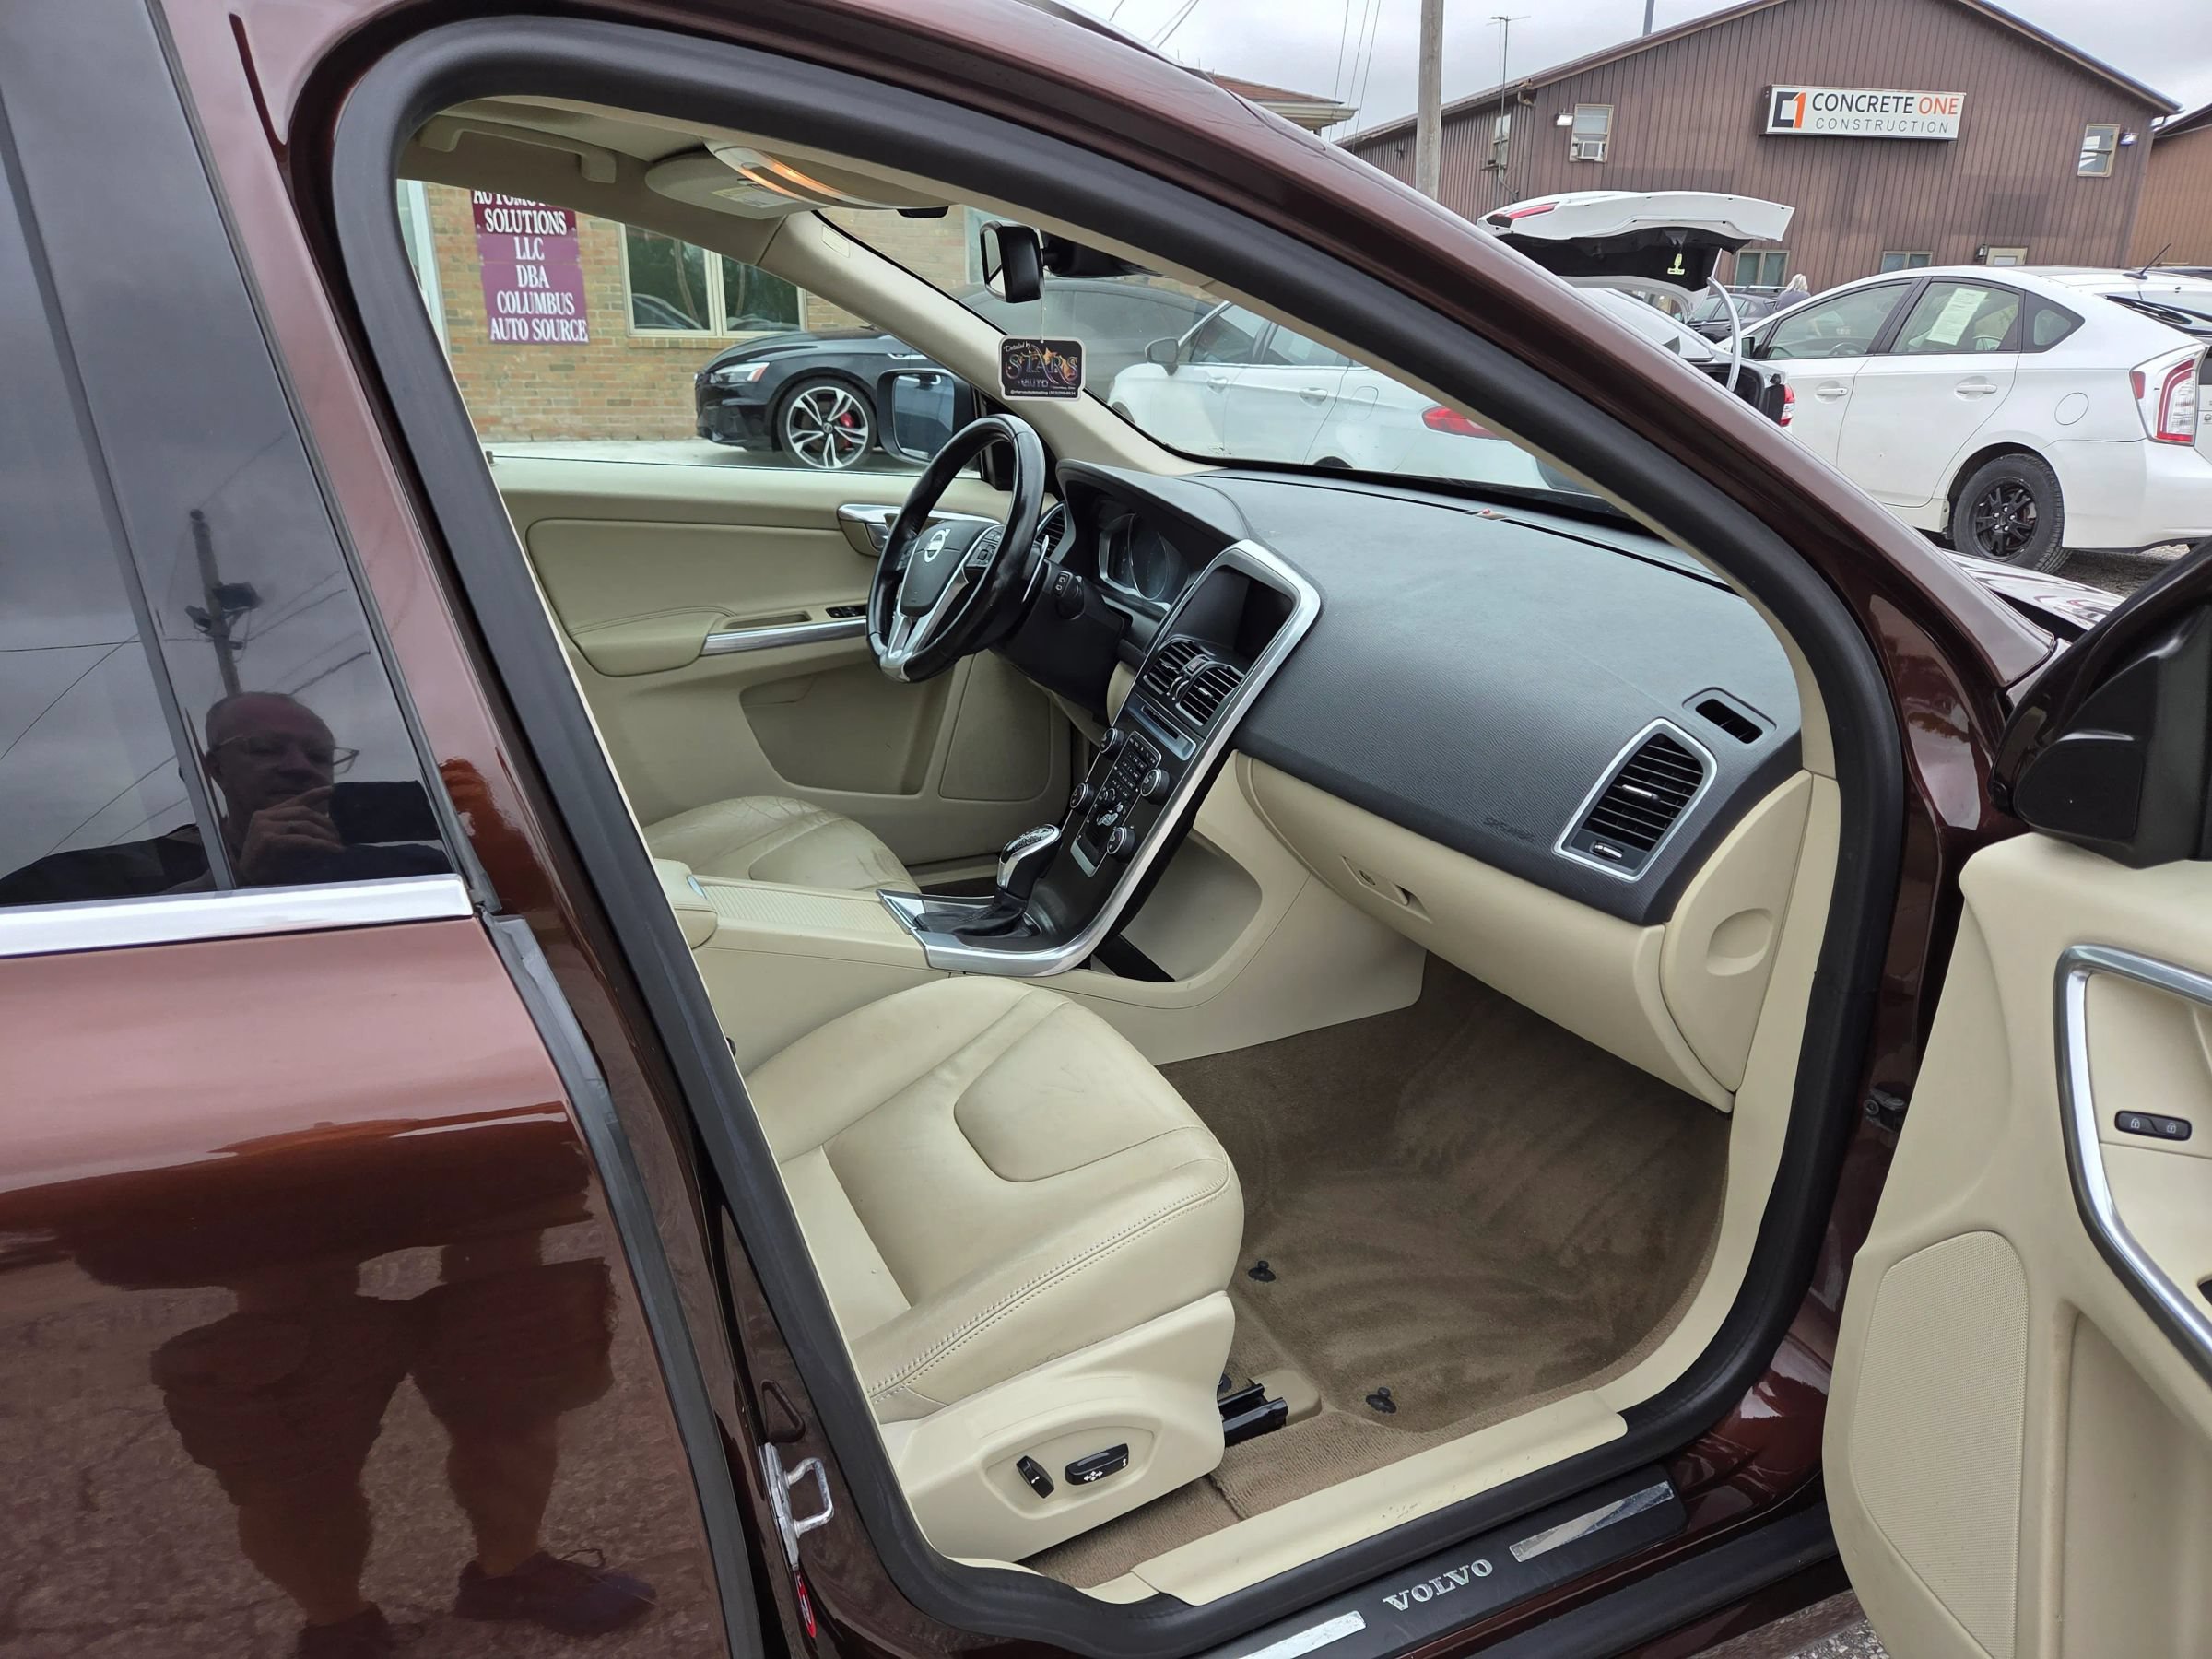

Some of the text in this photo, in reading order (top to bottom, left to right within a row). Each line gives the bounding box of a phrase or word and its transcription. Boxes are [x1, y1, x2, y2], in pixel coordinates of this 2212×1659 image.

[1812, 92, 1959, 115] CONCRETE ONE
[1815, 117, 1948, 134] CONSTRUCTION
[484, 208, 567, 236] SOLUTIONS
[513, 236, 545, 261] LLC
[516, 265, 550, 288] DBA
[497, 290, 576, 316] COLUMBUS
[490, 317, 589, 343] AUTO SOURCE
[1382, 1559, 1494, 1612] VOLVO
